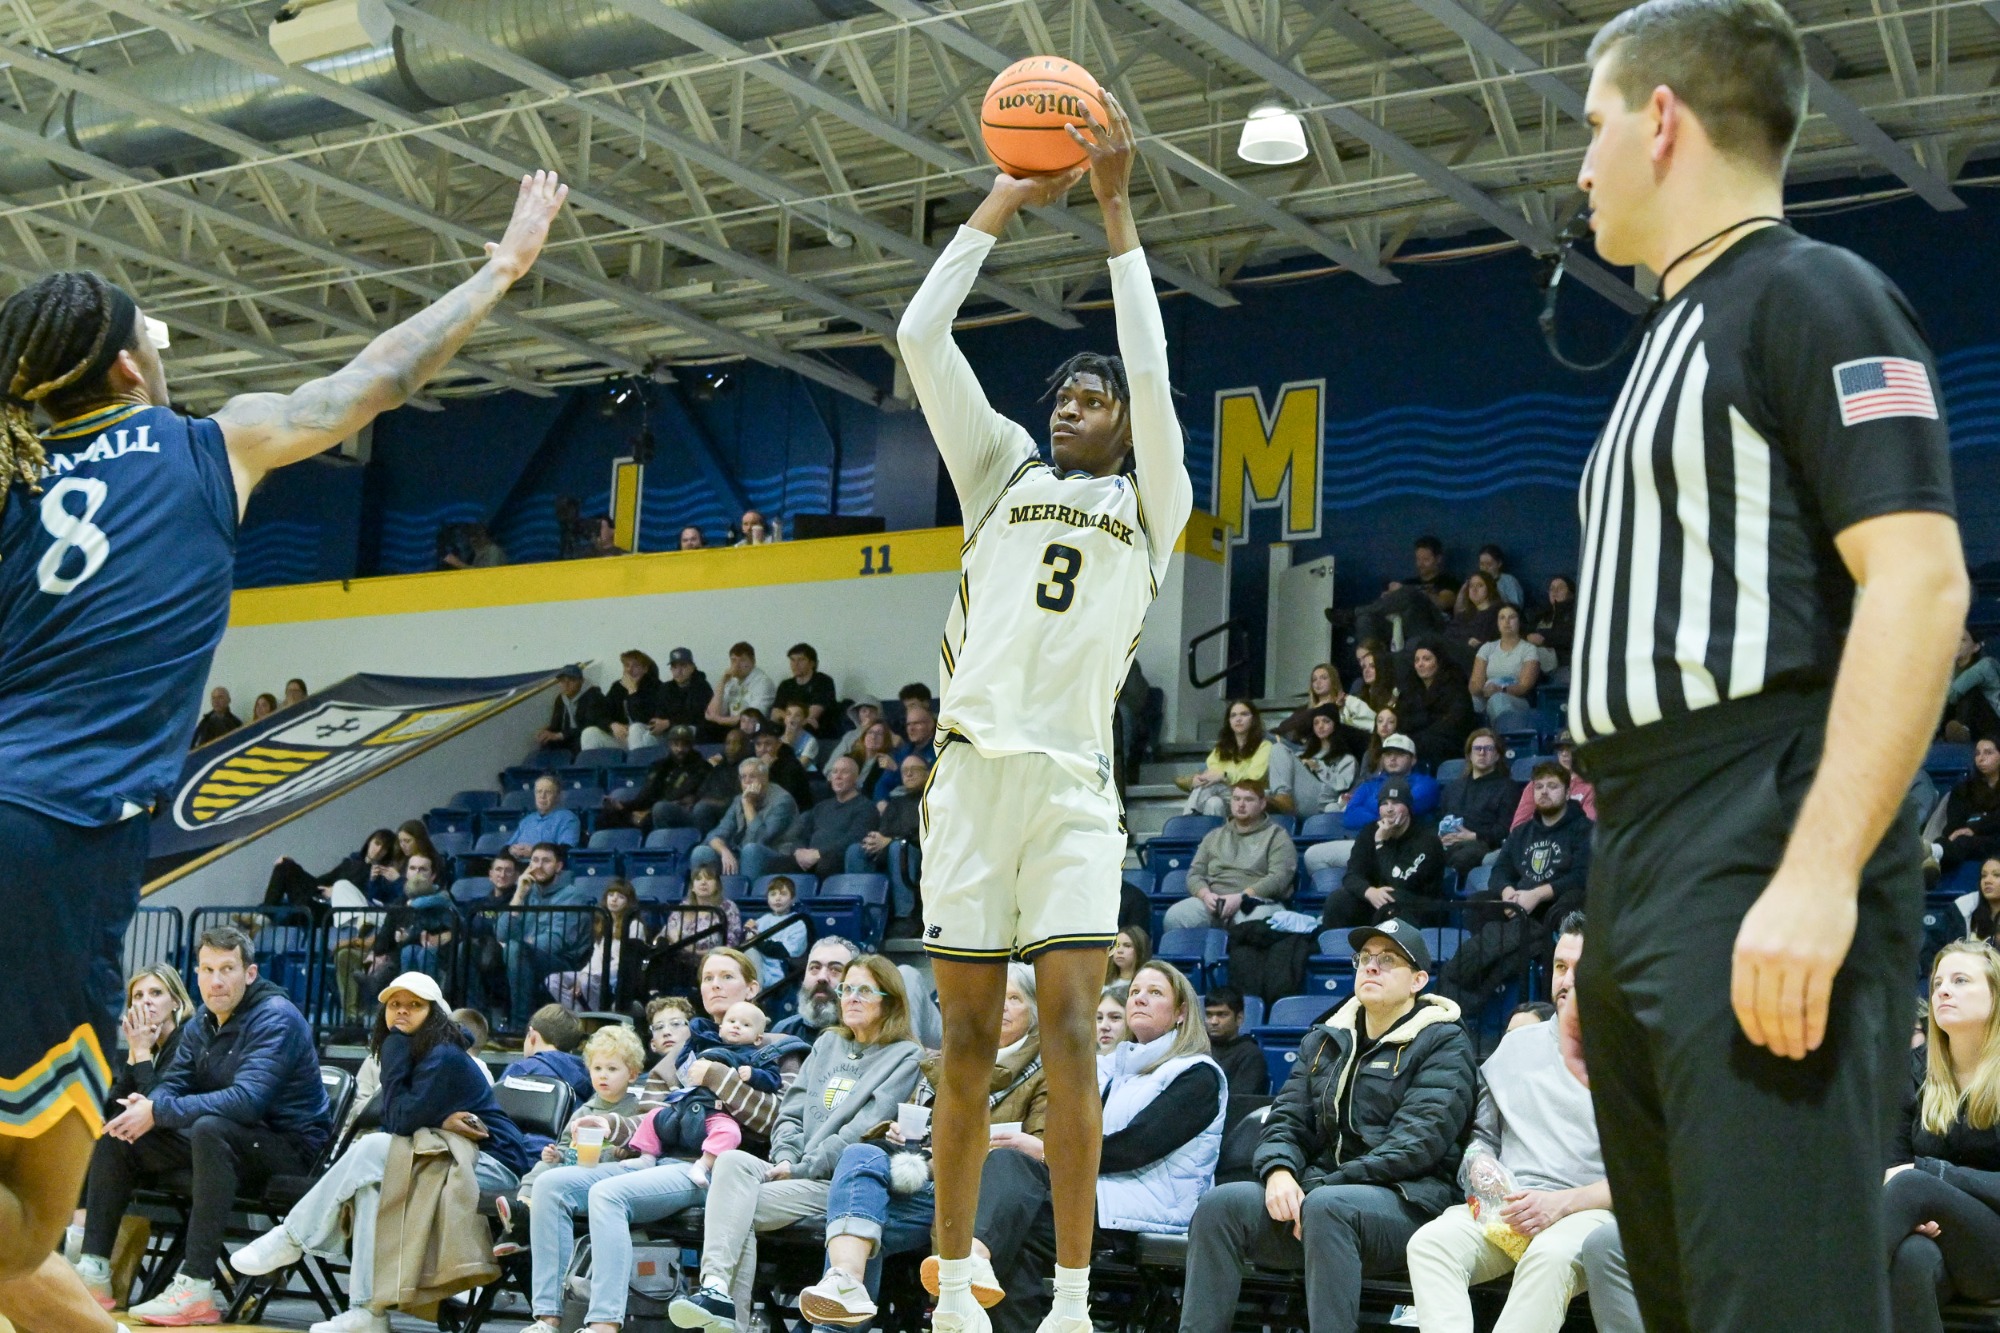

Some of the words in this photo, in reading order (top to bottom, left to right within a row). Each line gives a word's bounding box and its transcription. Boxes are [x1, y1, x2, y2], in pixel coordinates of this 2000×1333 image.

[999, 93, 1083, 118] Wilson
[1211, 378, 1326, 546] M
[37, 477, 110, 595] 8
[1009, 504, 1135, 546] MERRIMACK
[859, 544, 894, 575] 11
[1036, 542, 1083, 615] 3
